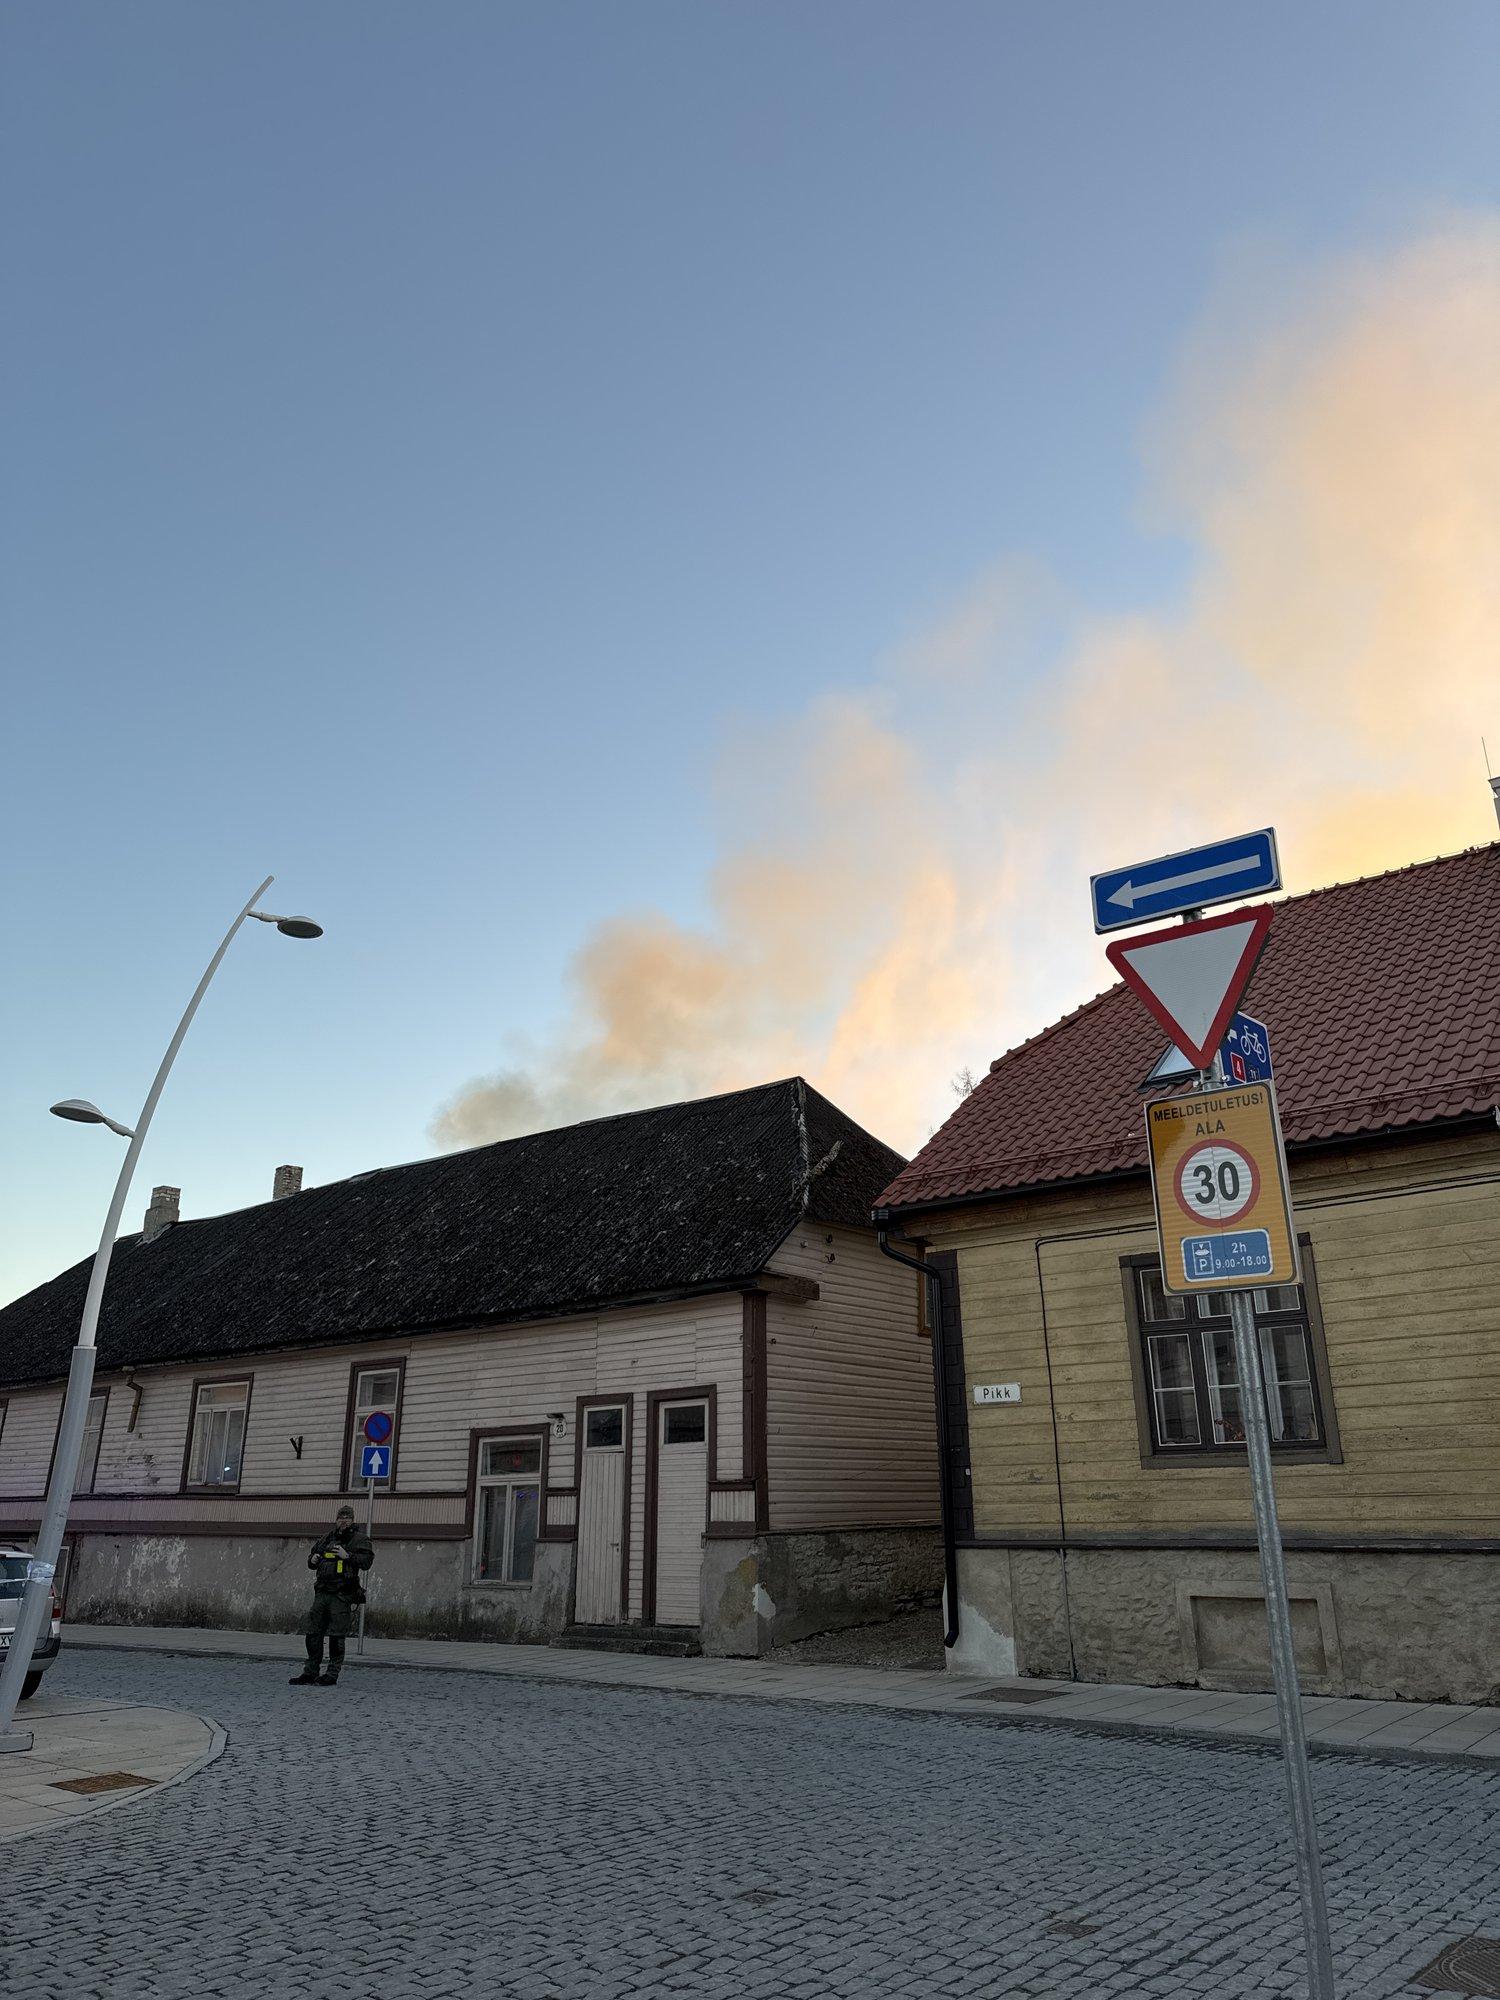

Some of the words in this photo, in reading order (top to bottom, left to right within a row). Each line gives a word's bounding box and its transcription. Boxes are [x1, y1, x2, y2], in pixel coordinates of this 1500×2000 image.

[1236, 1060, 1242, 1076] 4
[1154, 1092, 1264, 1122] MEELDETULETUS!
[1195, 1119, 1226, 1136] ALA
[1192, 1161, 1240, 1204] 30
[1231, 1241, 1247, 1253] 2h
[1199, 1258, 1208, 1271] P
[1215, 1255, 1267, 1269] 9.00-18.00
[983, 1387, 1011, 1399] Pikk
